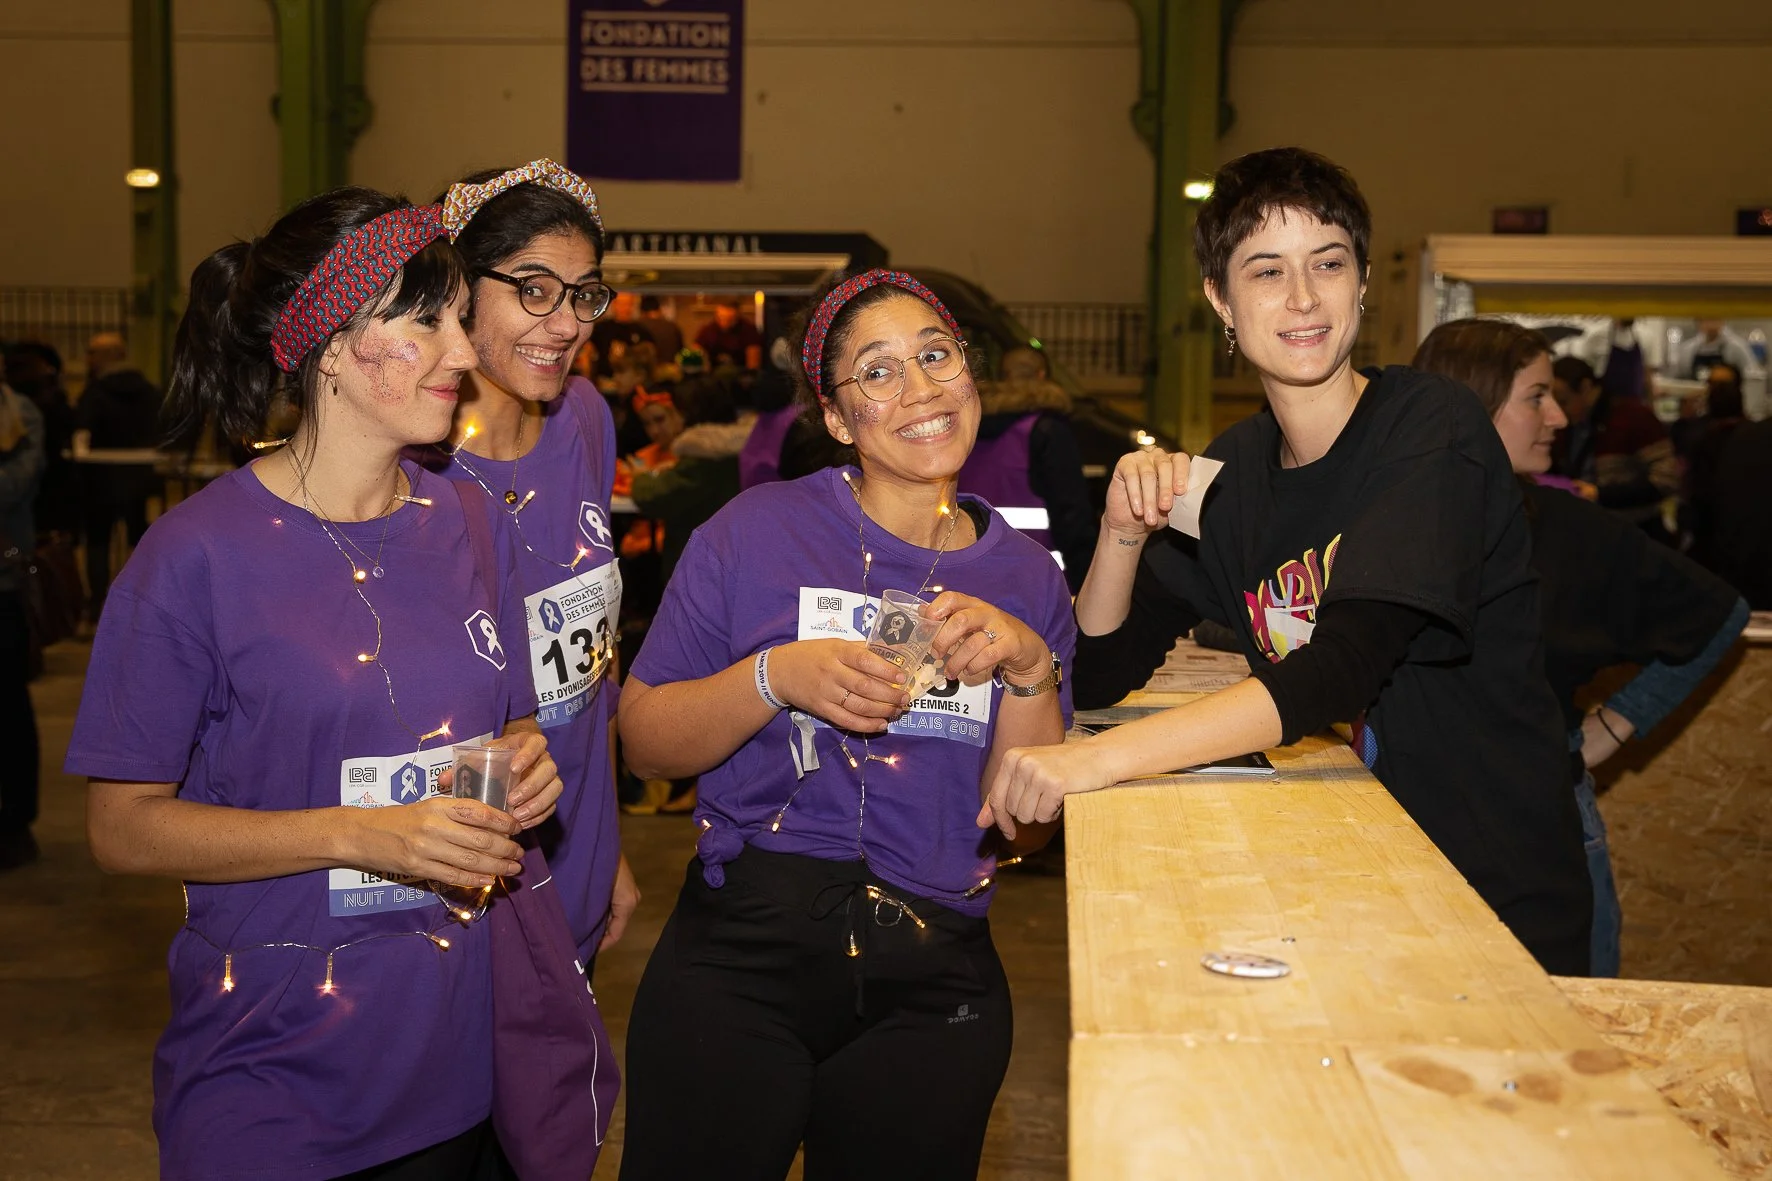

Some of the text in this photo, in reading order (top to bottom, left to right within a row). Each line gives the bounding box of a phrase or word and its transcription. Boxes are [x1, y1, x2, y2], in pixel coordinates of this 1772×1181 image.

[580, 21, 731, 47] FONDATION
[580, 57, 730, 83] DES FEMMES
[611, 234, 763, 253] ARTISANAL
[560, 585, 604, 608] FONDATION
[565, 610, 580, 621] DES
[581, 598, 606, 614] FEMMES
[542, 617, 608, 685] 133
[963, 704, 969, 714] 2
[949, 720, 980, 738] 2019
[361, 870, 383, 884] LES
[344, 891, 385, 908] NUIT
[393, 887, 425, 903] DES
